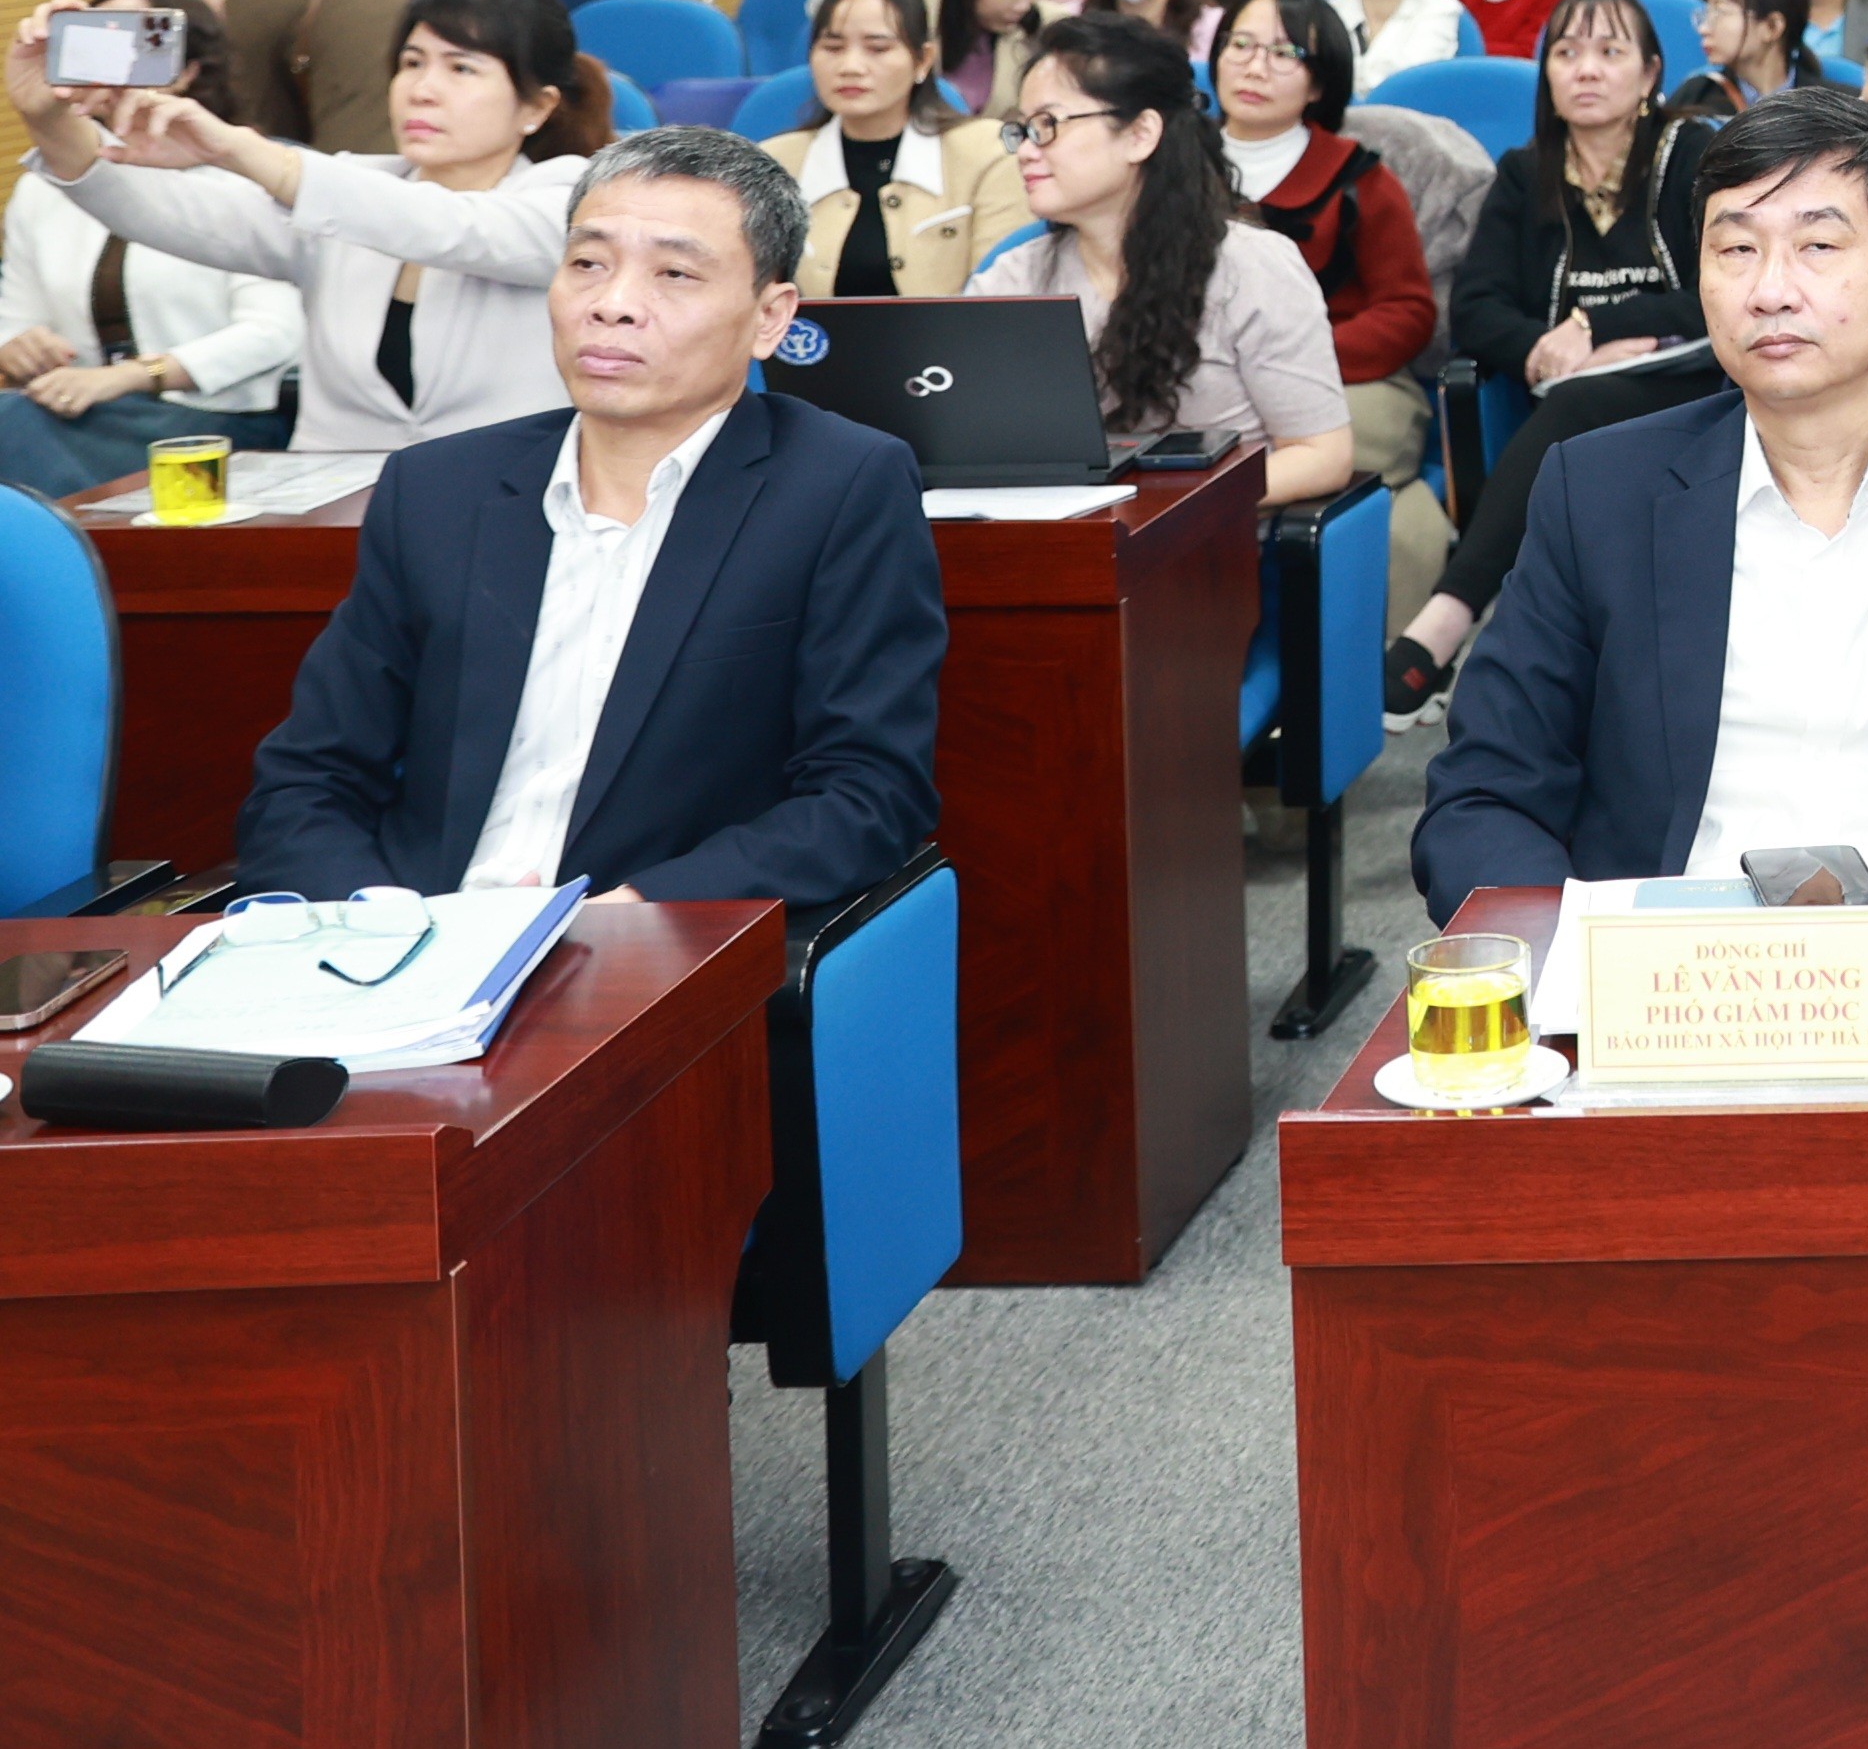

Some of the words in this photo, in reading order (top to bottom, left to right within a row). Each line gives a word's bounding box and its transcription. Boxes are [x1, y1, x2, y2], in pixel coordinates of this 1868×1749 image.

[1766, 936, 1806, 959] CHÍ
[1652, 963, 1692, 993] LÊ
[1700, 963, 1765, 992] VĂN
[1774, 967, 1862, 991] LONG
[1645, 998, 1705, 1025] PHÓ
[1712, 997, 1791, 1024] GIÁM
[1799, 996, 1861, 1022] ĐỐC
[1718, 1028, 1747, 1048] XÃ
[1754, 1030, 1792, 1050] HỘI
[1799, 1030, 1826, 1046] TP
[1831, 1025, 1860, 1046] HÀ
